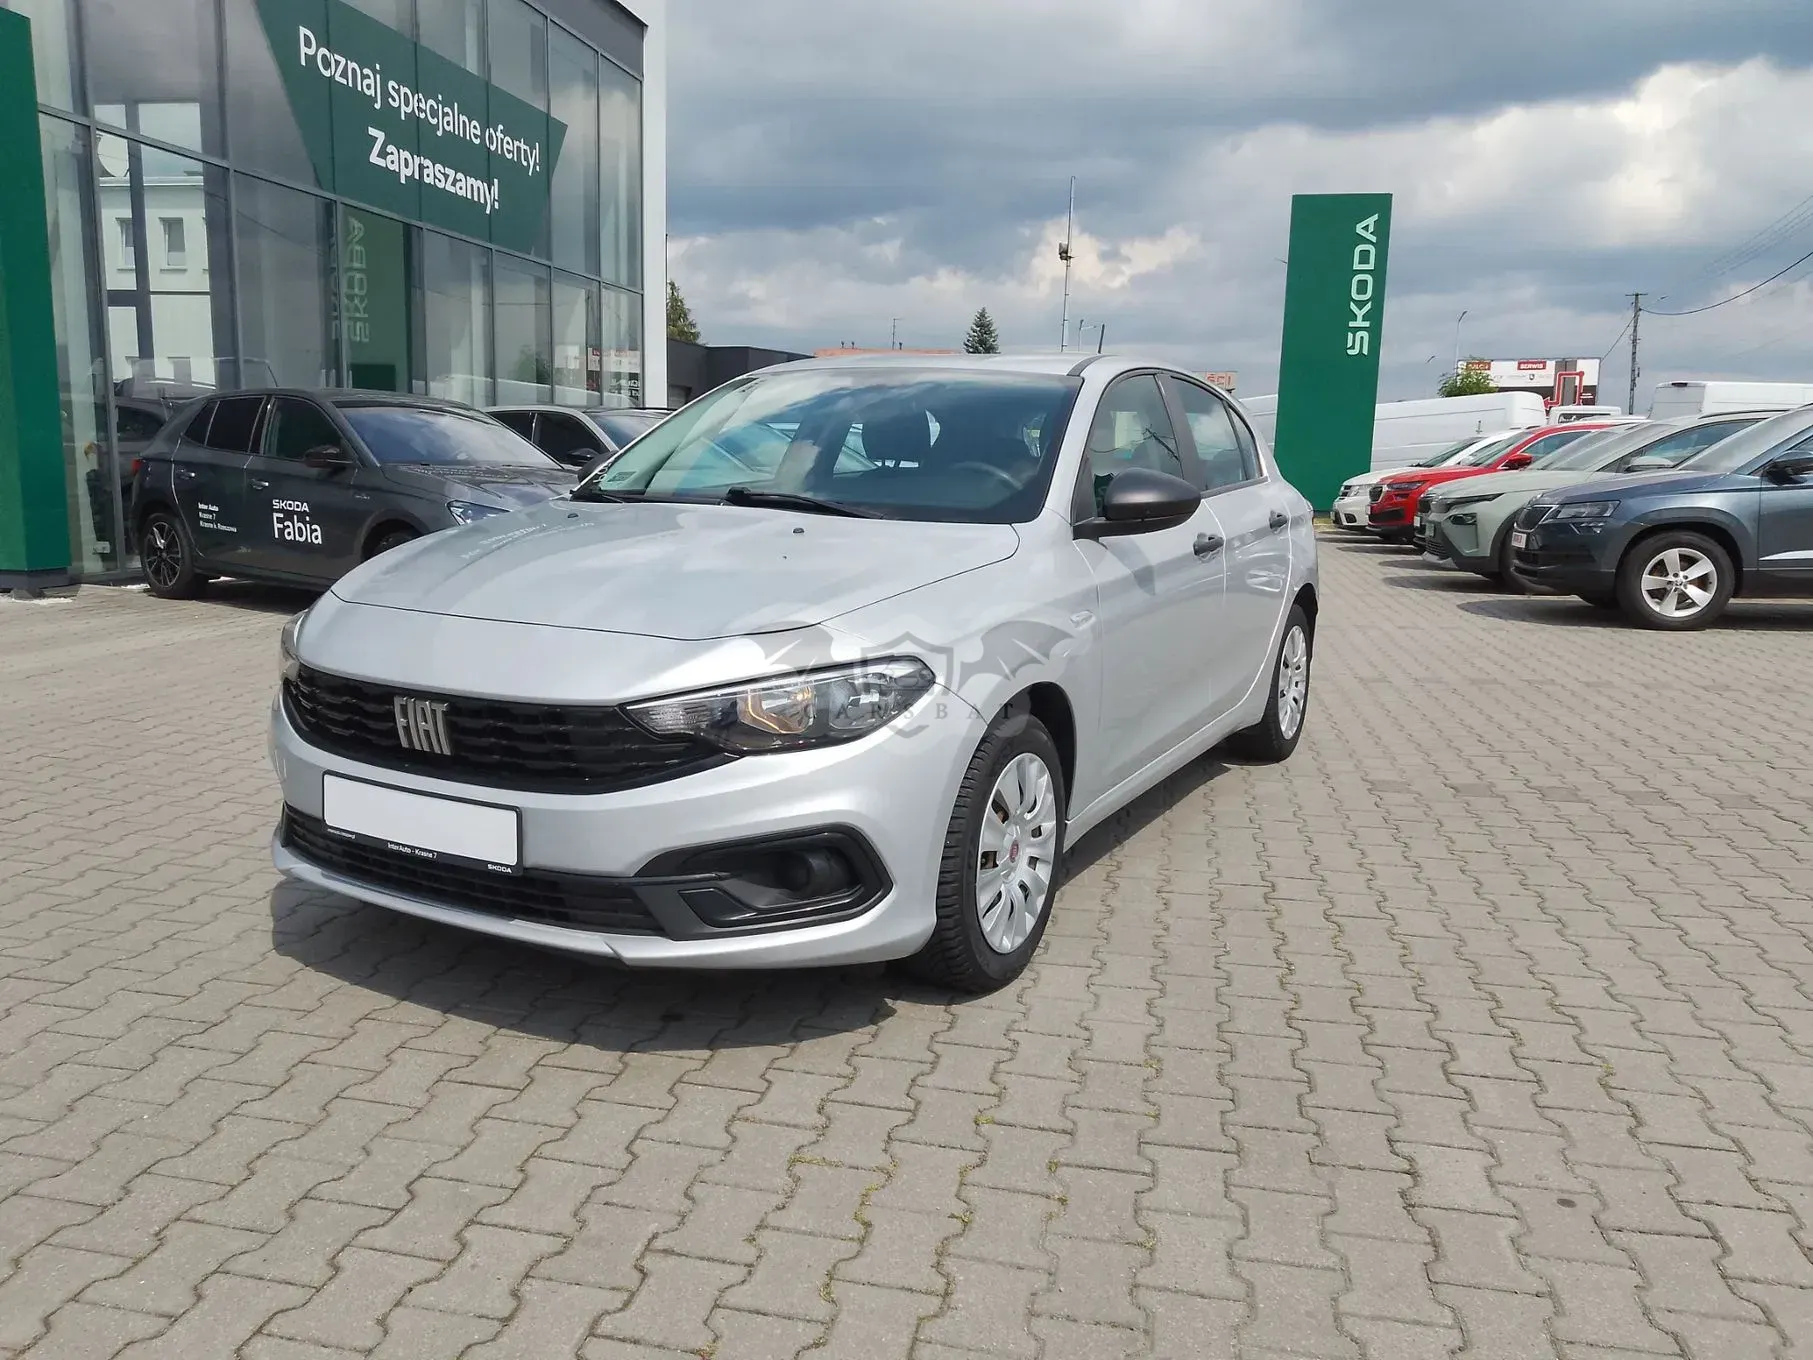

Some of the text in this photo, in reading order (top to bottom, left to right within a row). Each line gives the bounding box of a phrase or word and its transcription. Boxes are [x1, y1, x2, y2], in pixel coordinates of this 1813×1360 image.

[299, 25, 540, 177] Poznaj specjalne oferty!
[368, 126, 499, 215] Zapraszamy!
[273, 512, 322, 545] Fabia
[393, 695, 451, 756] FIAT
